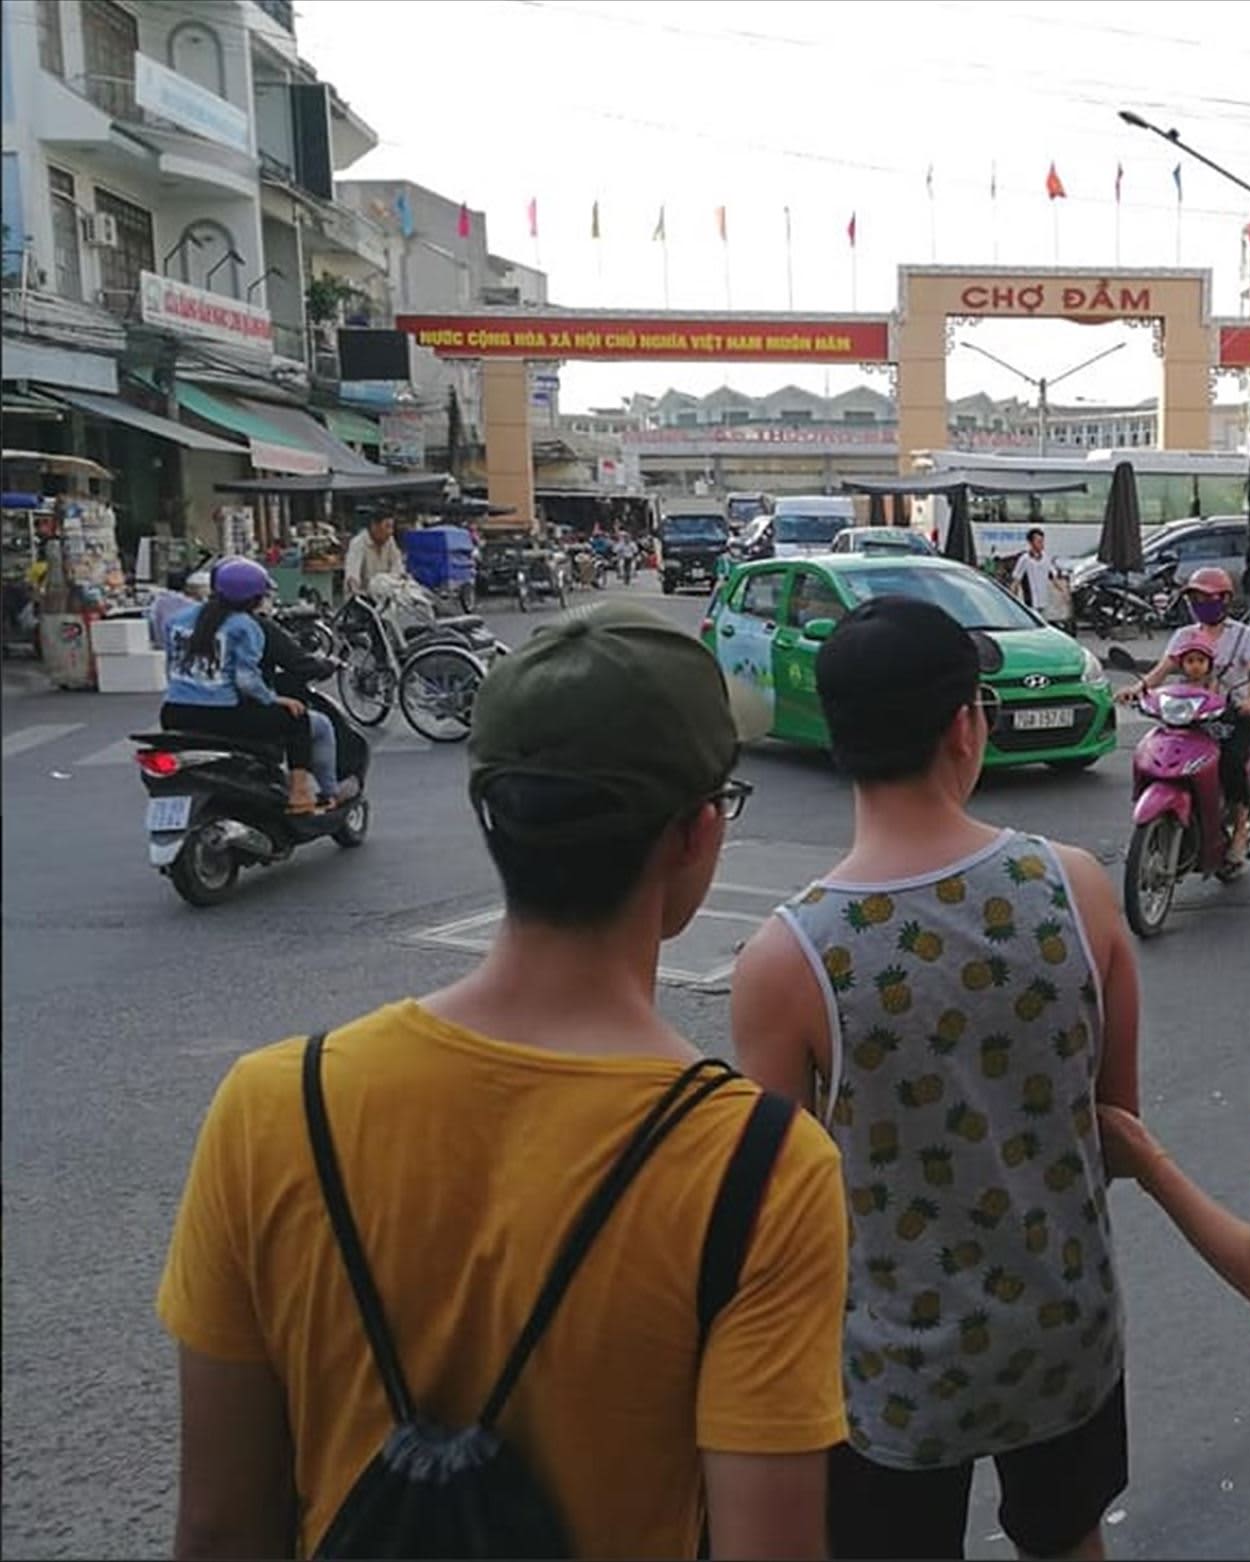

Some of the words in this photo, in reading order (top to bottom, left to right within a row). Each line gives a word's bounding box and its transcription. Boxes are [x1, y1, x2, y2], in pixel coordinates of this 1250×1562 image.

[961, 284, 1044, 313] CHỢ
[466, 329, 511, 349] CỘNG
[576, 331, 600, 350] HỘI
[691, 333, 722, 351] VIỆT
[727, 334, 762, 350] NAM
